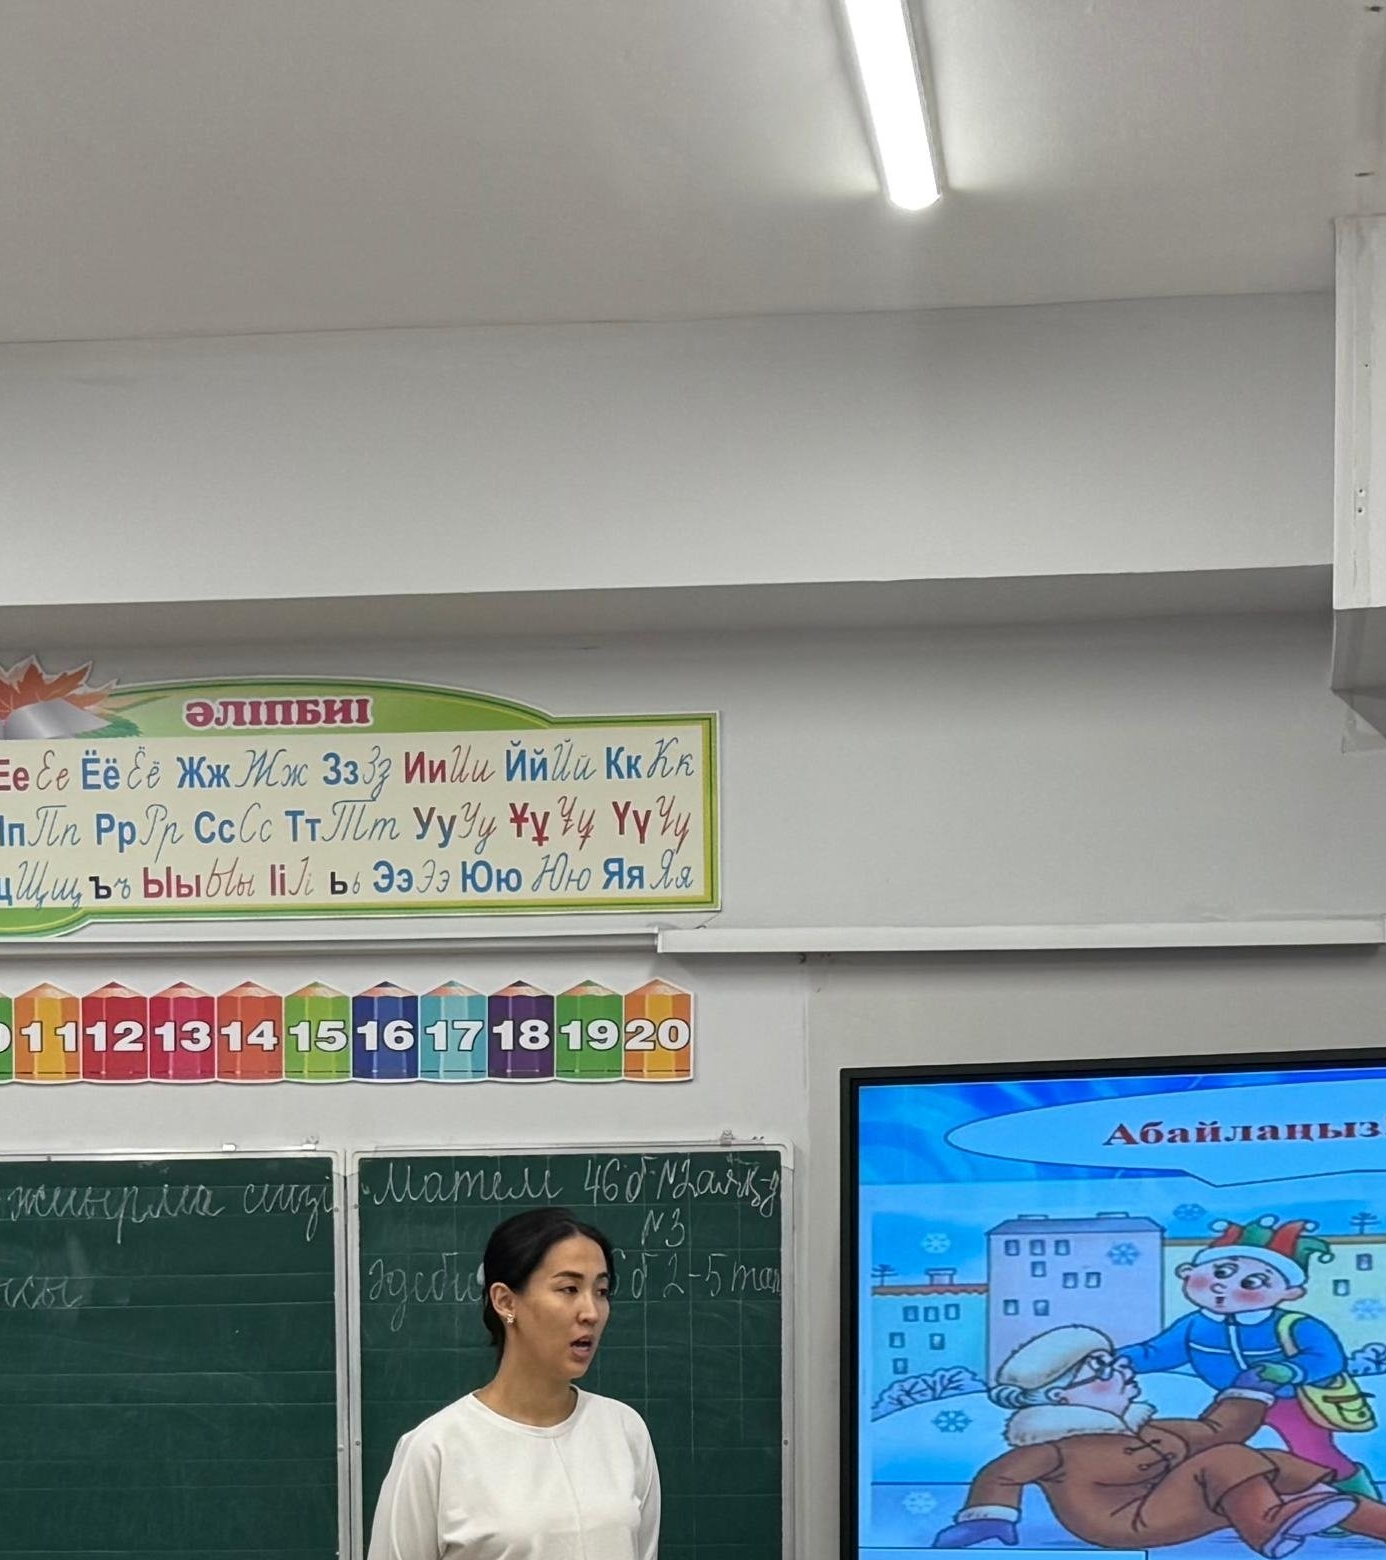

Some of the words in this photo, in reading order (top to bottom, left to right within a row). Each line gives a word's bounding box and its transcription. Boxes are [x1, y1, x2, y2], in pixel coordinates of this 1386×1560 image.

[186, 699, 371, 727] ӘЛІПБИІ
[20, 1019, 78, 1053] 11
[85, 1019, 144, 1053] 12
[154, 1019, 212, 1053] 13
[220, 1019, 278, 1053] 14
[289, 1019, 349, 1053] 15
[356, 1019, 414, 1053] 16
[425, 1019, 483, 1053] 17
[492, 1019, 550, 1053] 18
[559, 1019, 619, 1053] 19
[624, 1019, 691, 1053] 20
